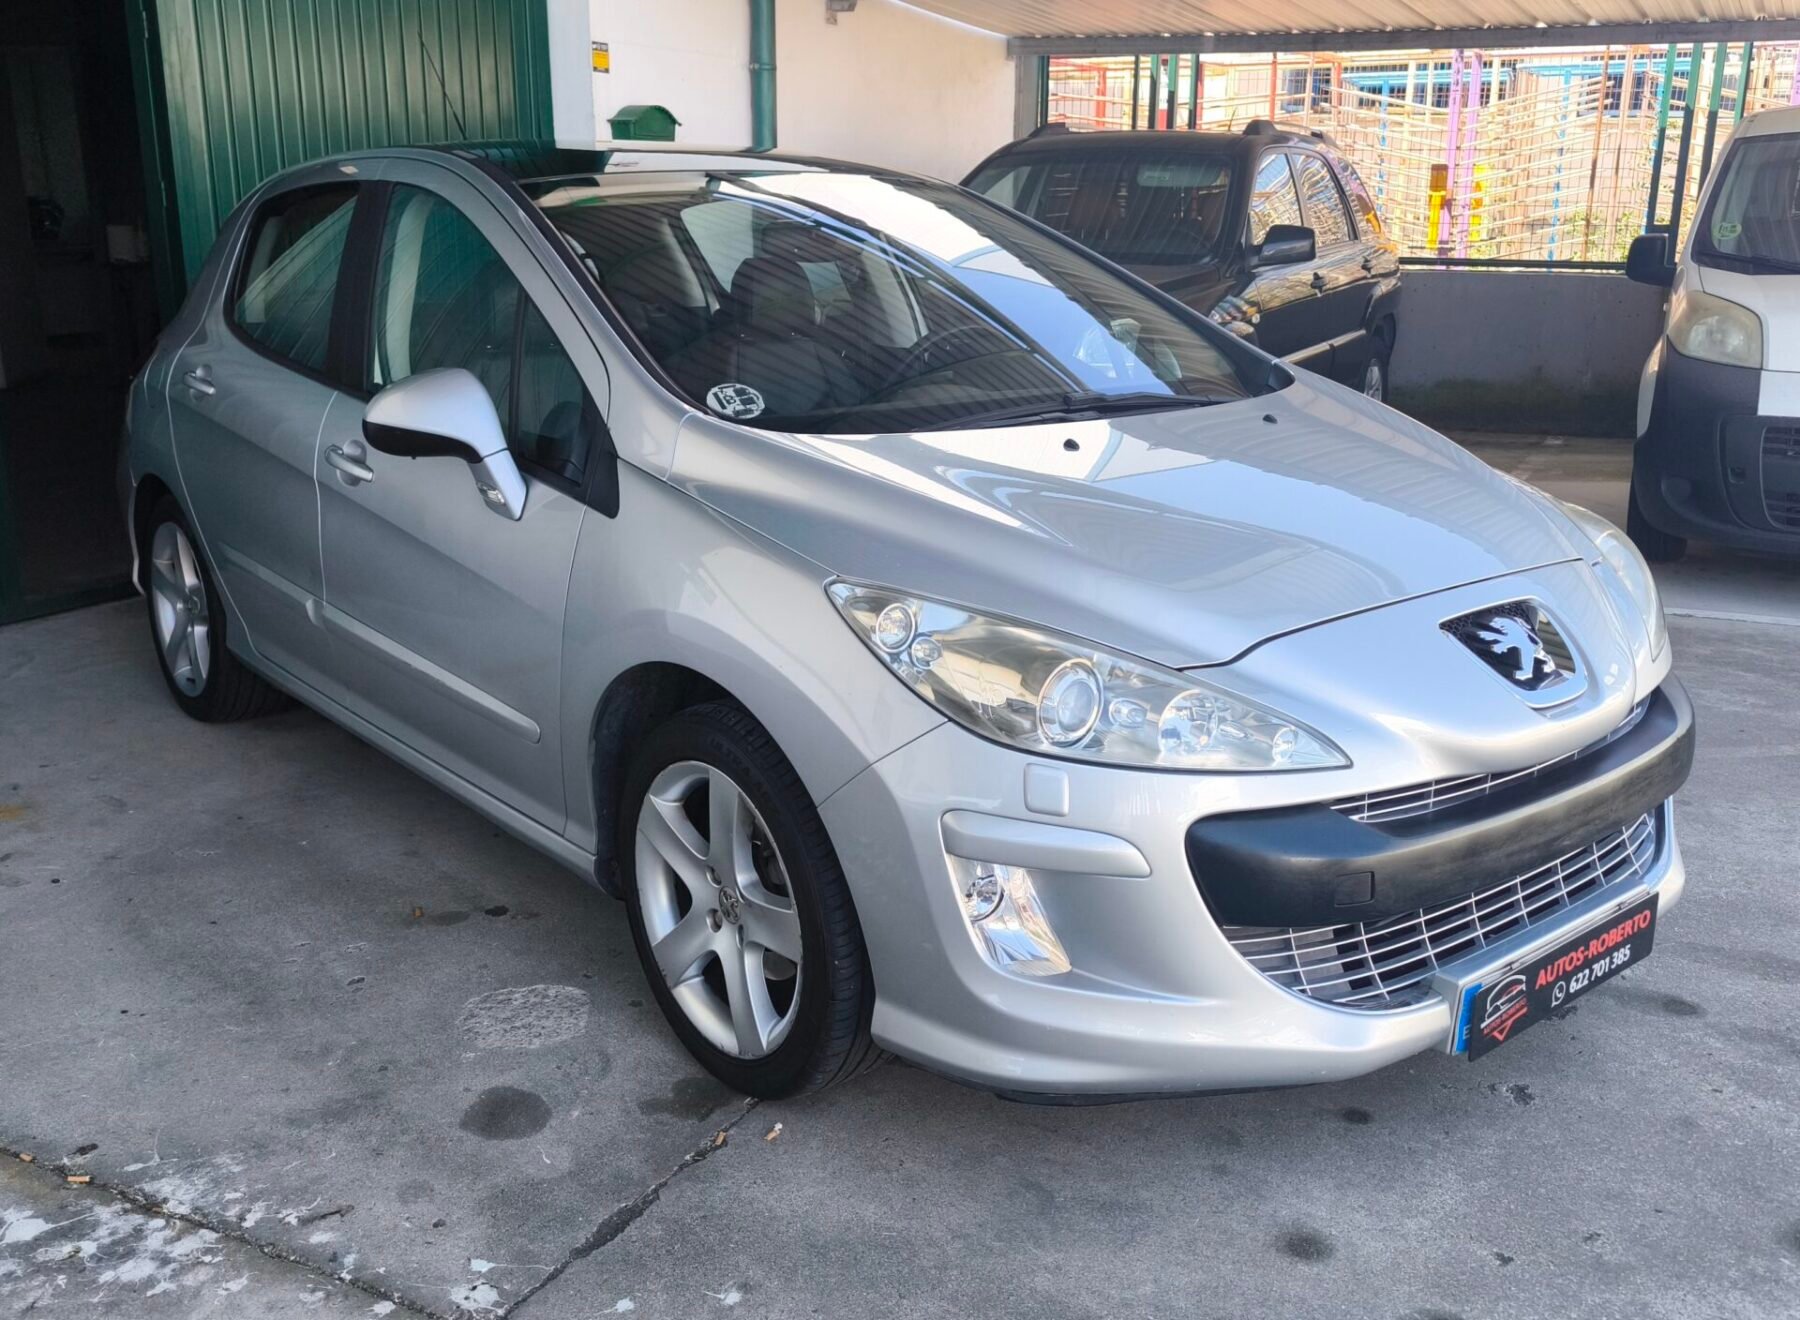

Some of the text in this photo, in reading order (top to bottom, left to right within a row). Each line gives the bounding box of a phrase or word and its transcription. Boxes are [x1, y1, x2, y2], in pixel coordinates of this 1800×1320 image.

[1534, 909, 1651, 990] AUTOS-ROBERTO
[1569, 944, 1631, 993] 622 701 385
[1463, 1024, 1471, 1040] E
